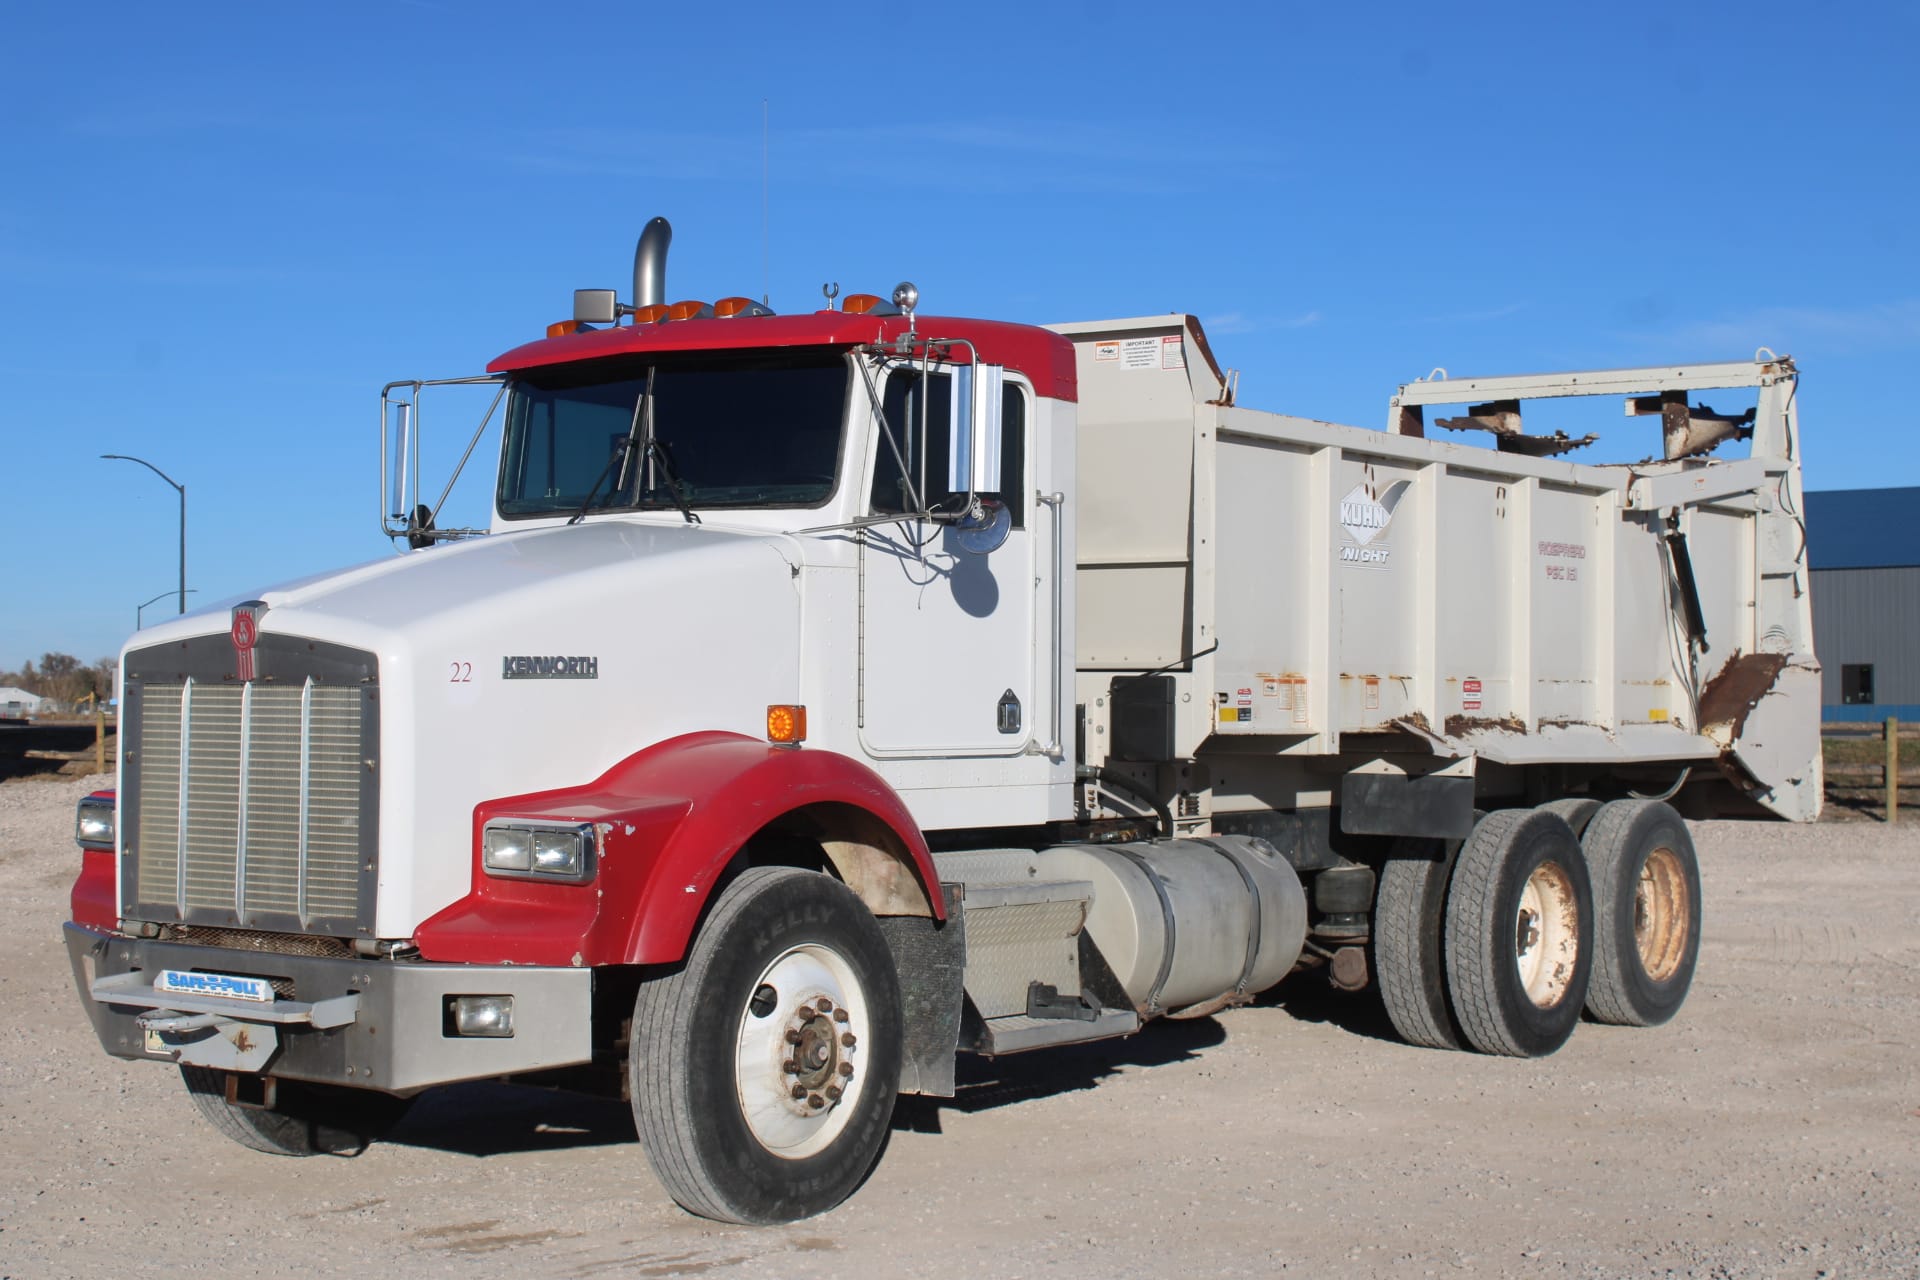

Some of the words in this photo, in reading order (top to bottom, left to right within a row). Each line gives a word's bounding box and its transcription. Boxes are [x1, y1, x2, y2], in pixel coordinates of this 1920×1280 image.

[1341, 502, 1383, 528] KUHN
[450, 662, 472, 683] 22
[502, 655, 599, 676] KENWORTH
[752, 904, 836, 953] KELLY
